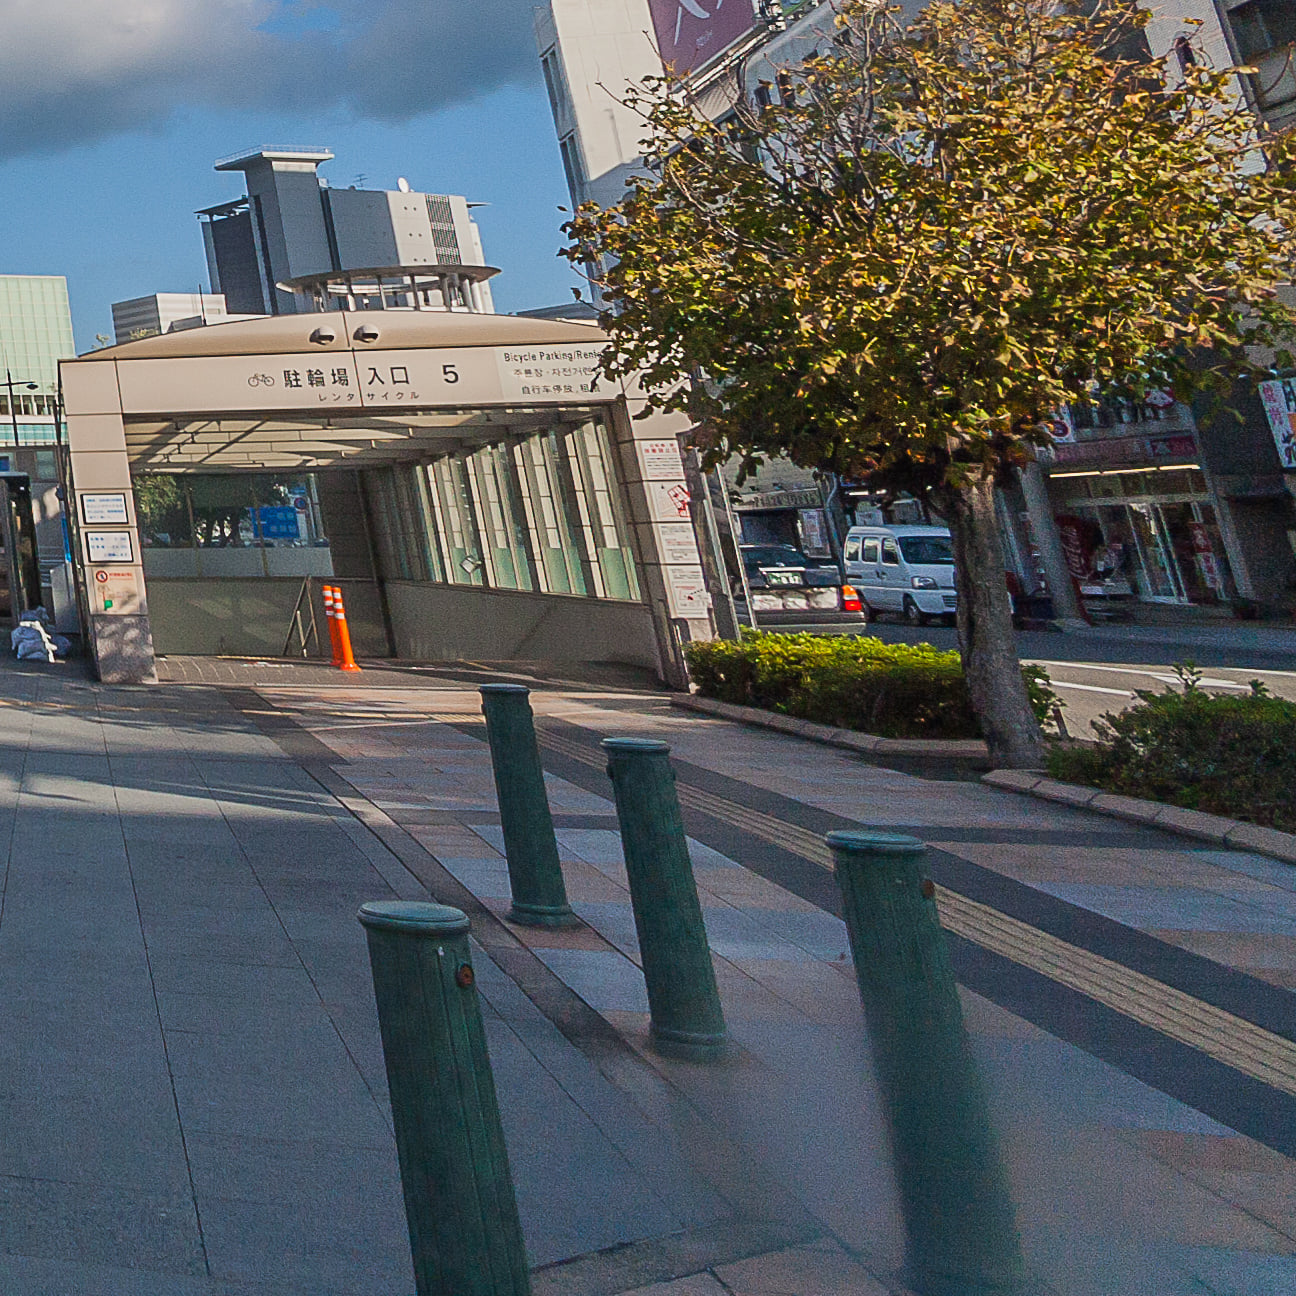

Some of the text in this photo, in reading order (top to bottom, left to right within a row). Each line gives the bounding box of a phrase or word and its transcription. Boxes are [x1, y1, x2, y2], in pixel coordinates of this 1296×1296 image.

[504, 352, 537, 364] Bicycle
[442, 364, 460, 384] 5
[319, 391, 420, 402] レンタサイクル
